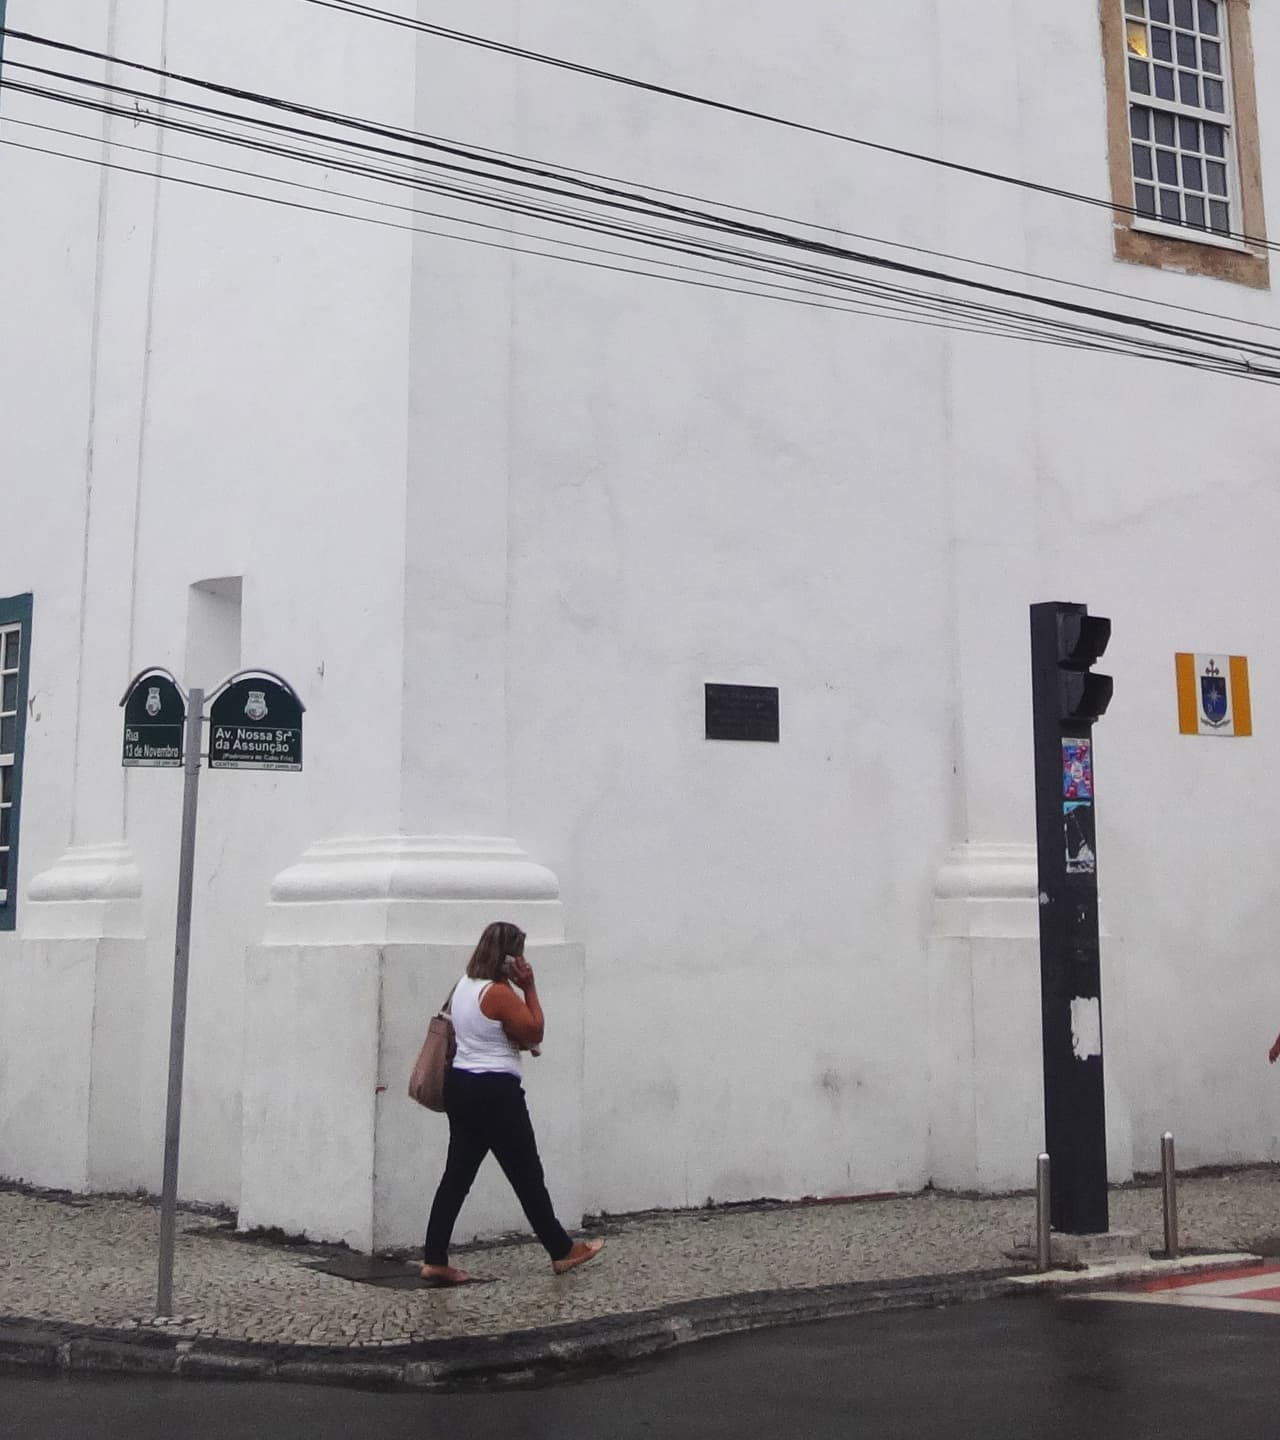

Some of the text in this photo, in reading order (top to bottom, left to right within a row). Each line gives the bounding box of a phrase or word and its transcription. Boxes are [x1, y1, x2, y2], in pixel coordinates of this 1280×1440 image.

[125, 728, 139, 742] Rua
[215, 727, 234, 739] Av.
[237, 728, 273, 741] Nossa
[125, 744, 179, 758] 13 de Novembro
[215, 739, 290, 754] da Assunção
